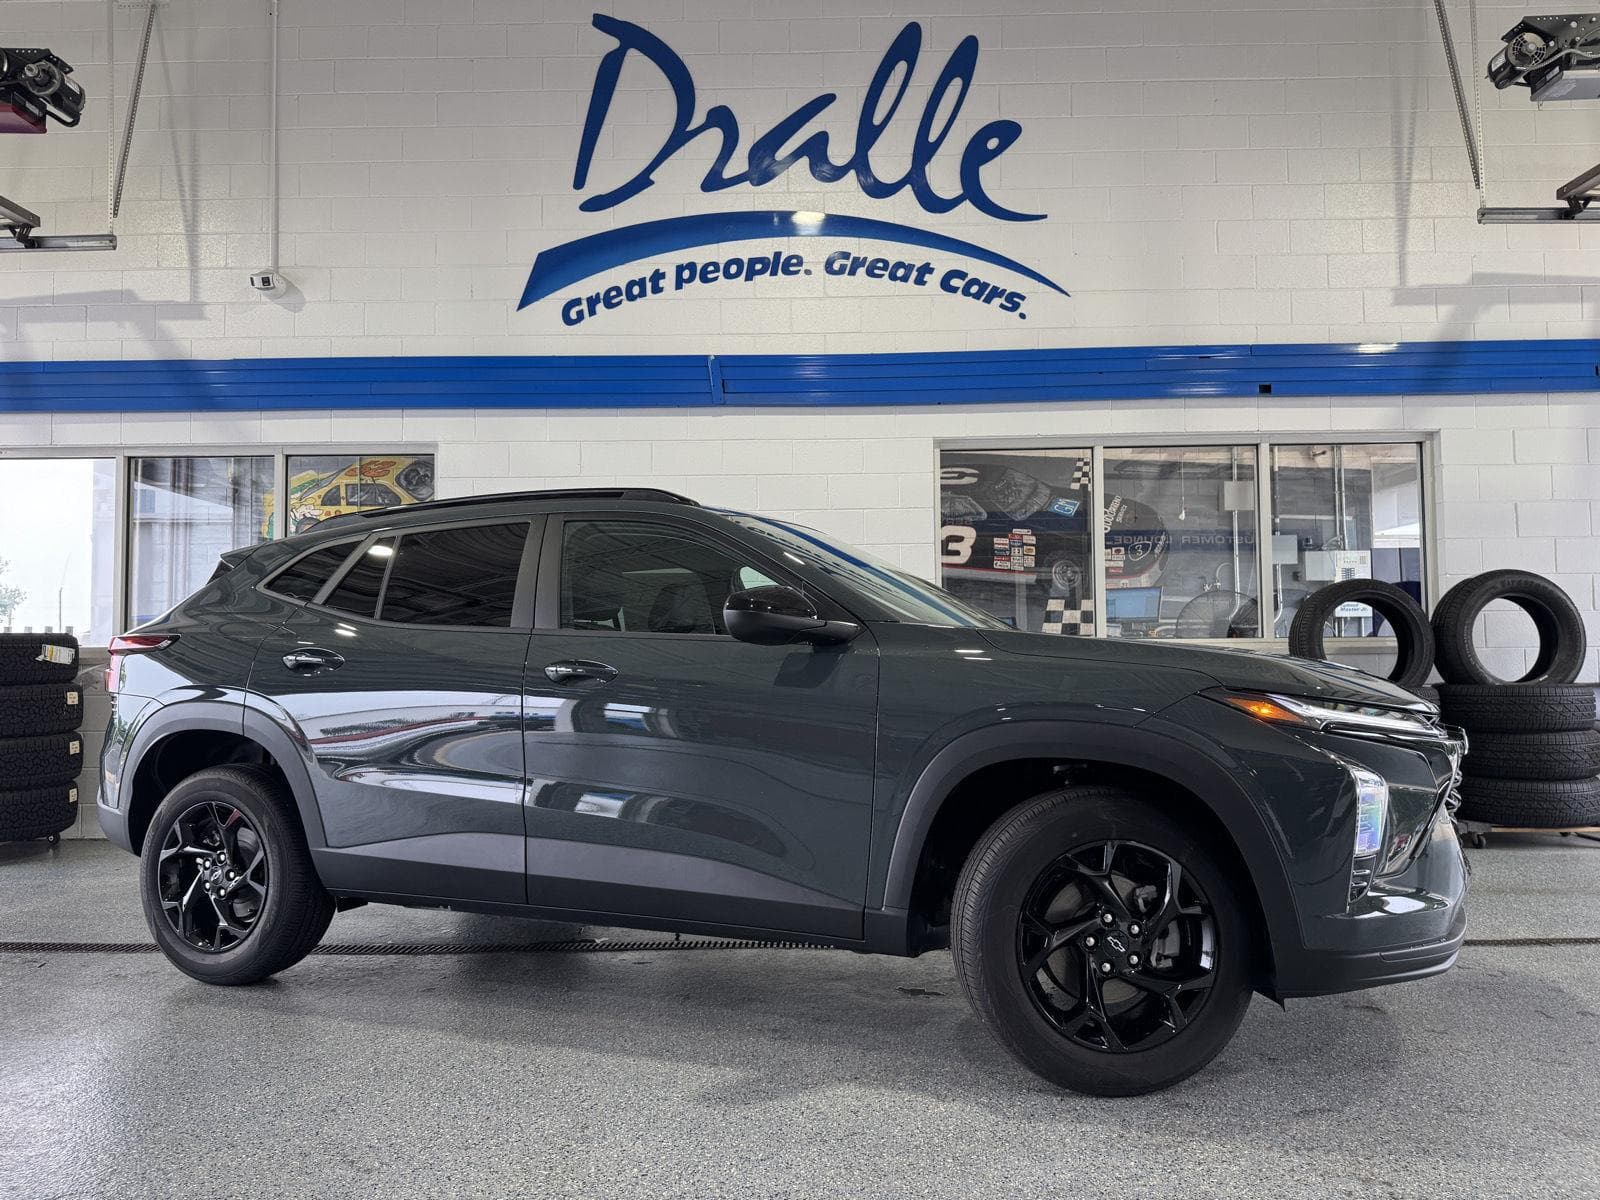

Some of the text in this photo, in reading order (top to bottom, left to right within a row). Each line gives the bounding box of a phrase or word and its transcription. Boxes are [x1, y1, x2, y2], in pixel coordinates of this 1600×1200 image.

[572, 13, 1048, 221] Dralle
[561, 250, 1027, 327] Great people. Great Cars.
[941, 525, 977, 564] 3
